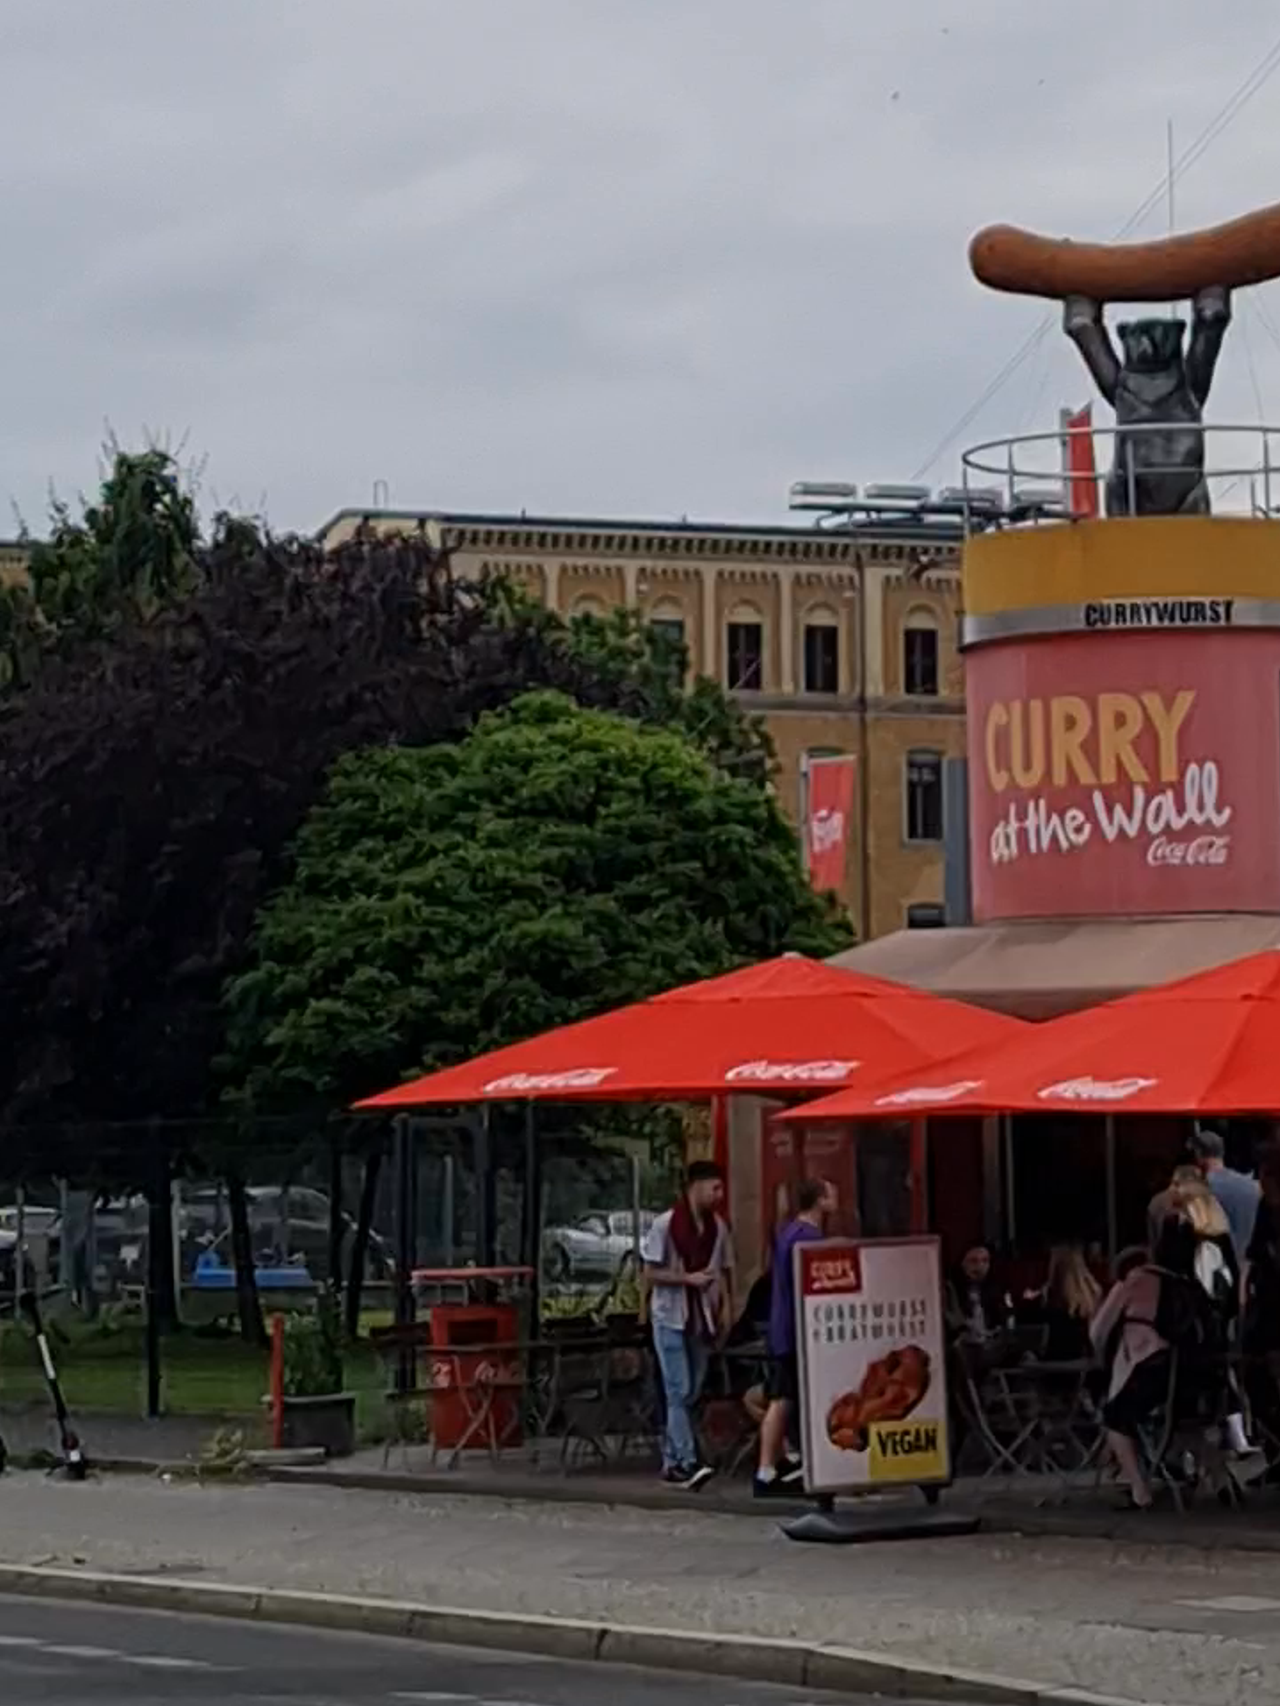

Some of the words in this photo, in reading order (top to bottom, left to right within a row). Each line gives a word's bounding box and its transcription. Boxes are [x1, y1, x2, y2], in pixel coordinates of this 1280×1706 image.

[1084, 600, 1234, 627] CURRYWURST
[986, 690, 1196, 792] CURRY
[990, 802, 1019, 864] at
[1023, 798, 1091, 853] the
[875, 1428, 939, 1457] VEGAN
